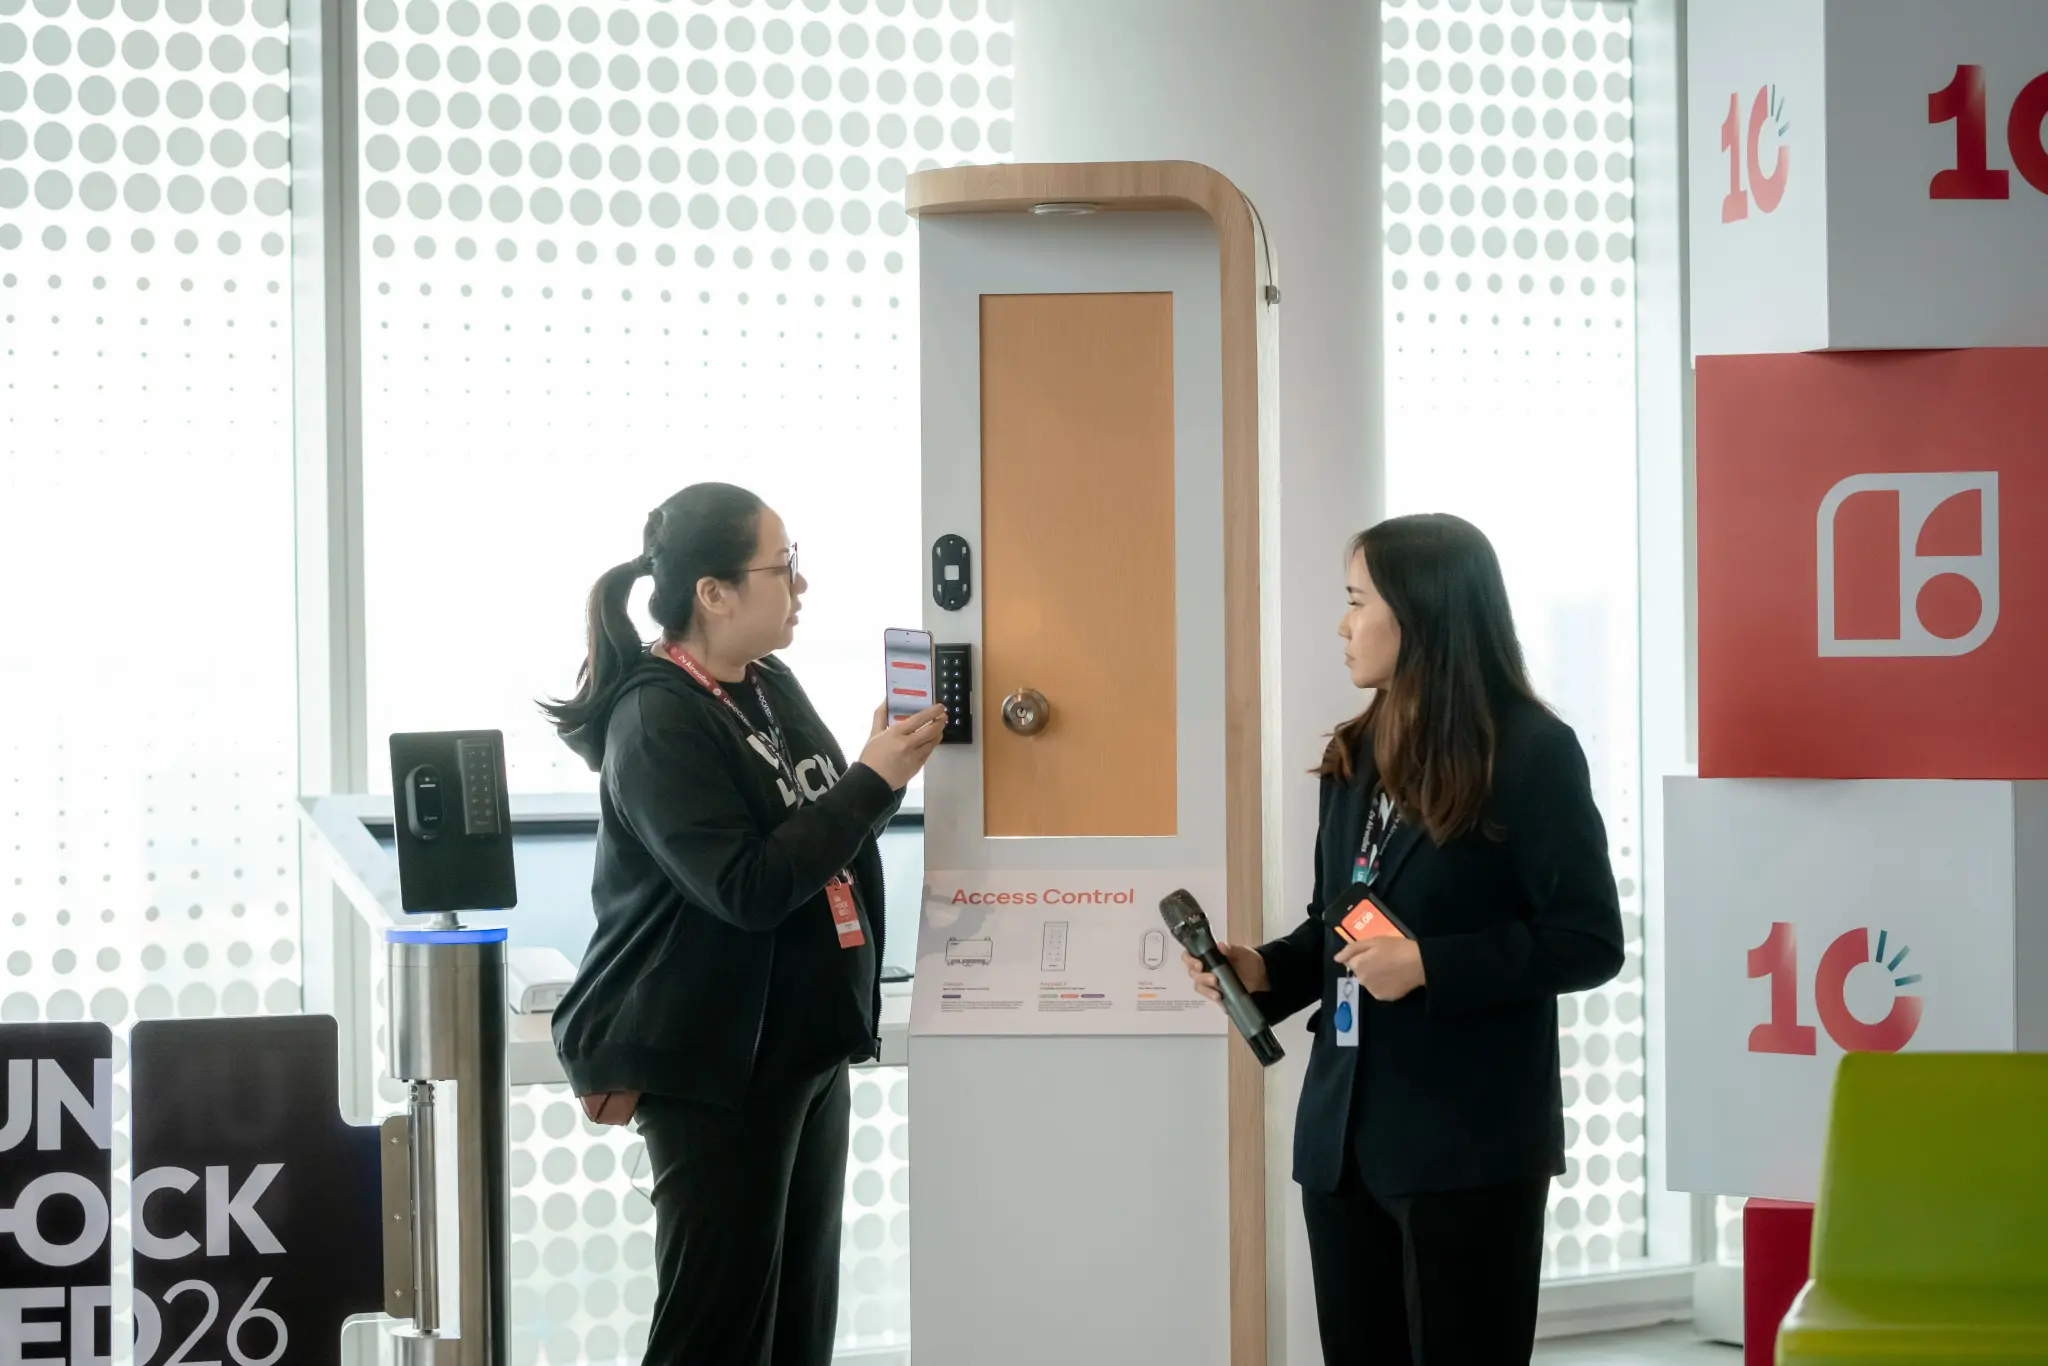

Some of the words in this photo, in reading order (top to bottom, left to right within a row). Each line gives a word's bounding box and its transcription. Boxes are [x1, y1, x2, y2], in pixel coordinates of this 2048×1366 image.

[776, 754, 841, 808] LCK
[951, 889, 1038, 905] Access
[1042, 888, 1134, 905] Control
[1747, 921, 1925, 1057] 10
